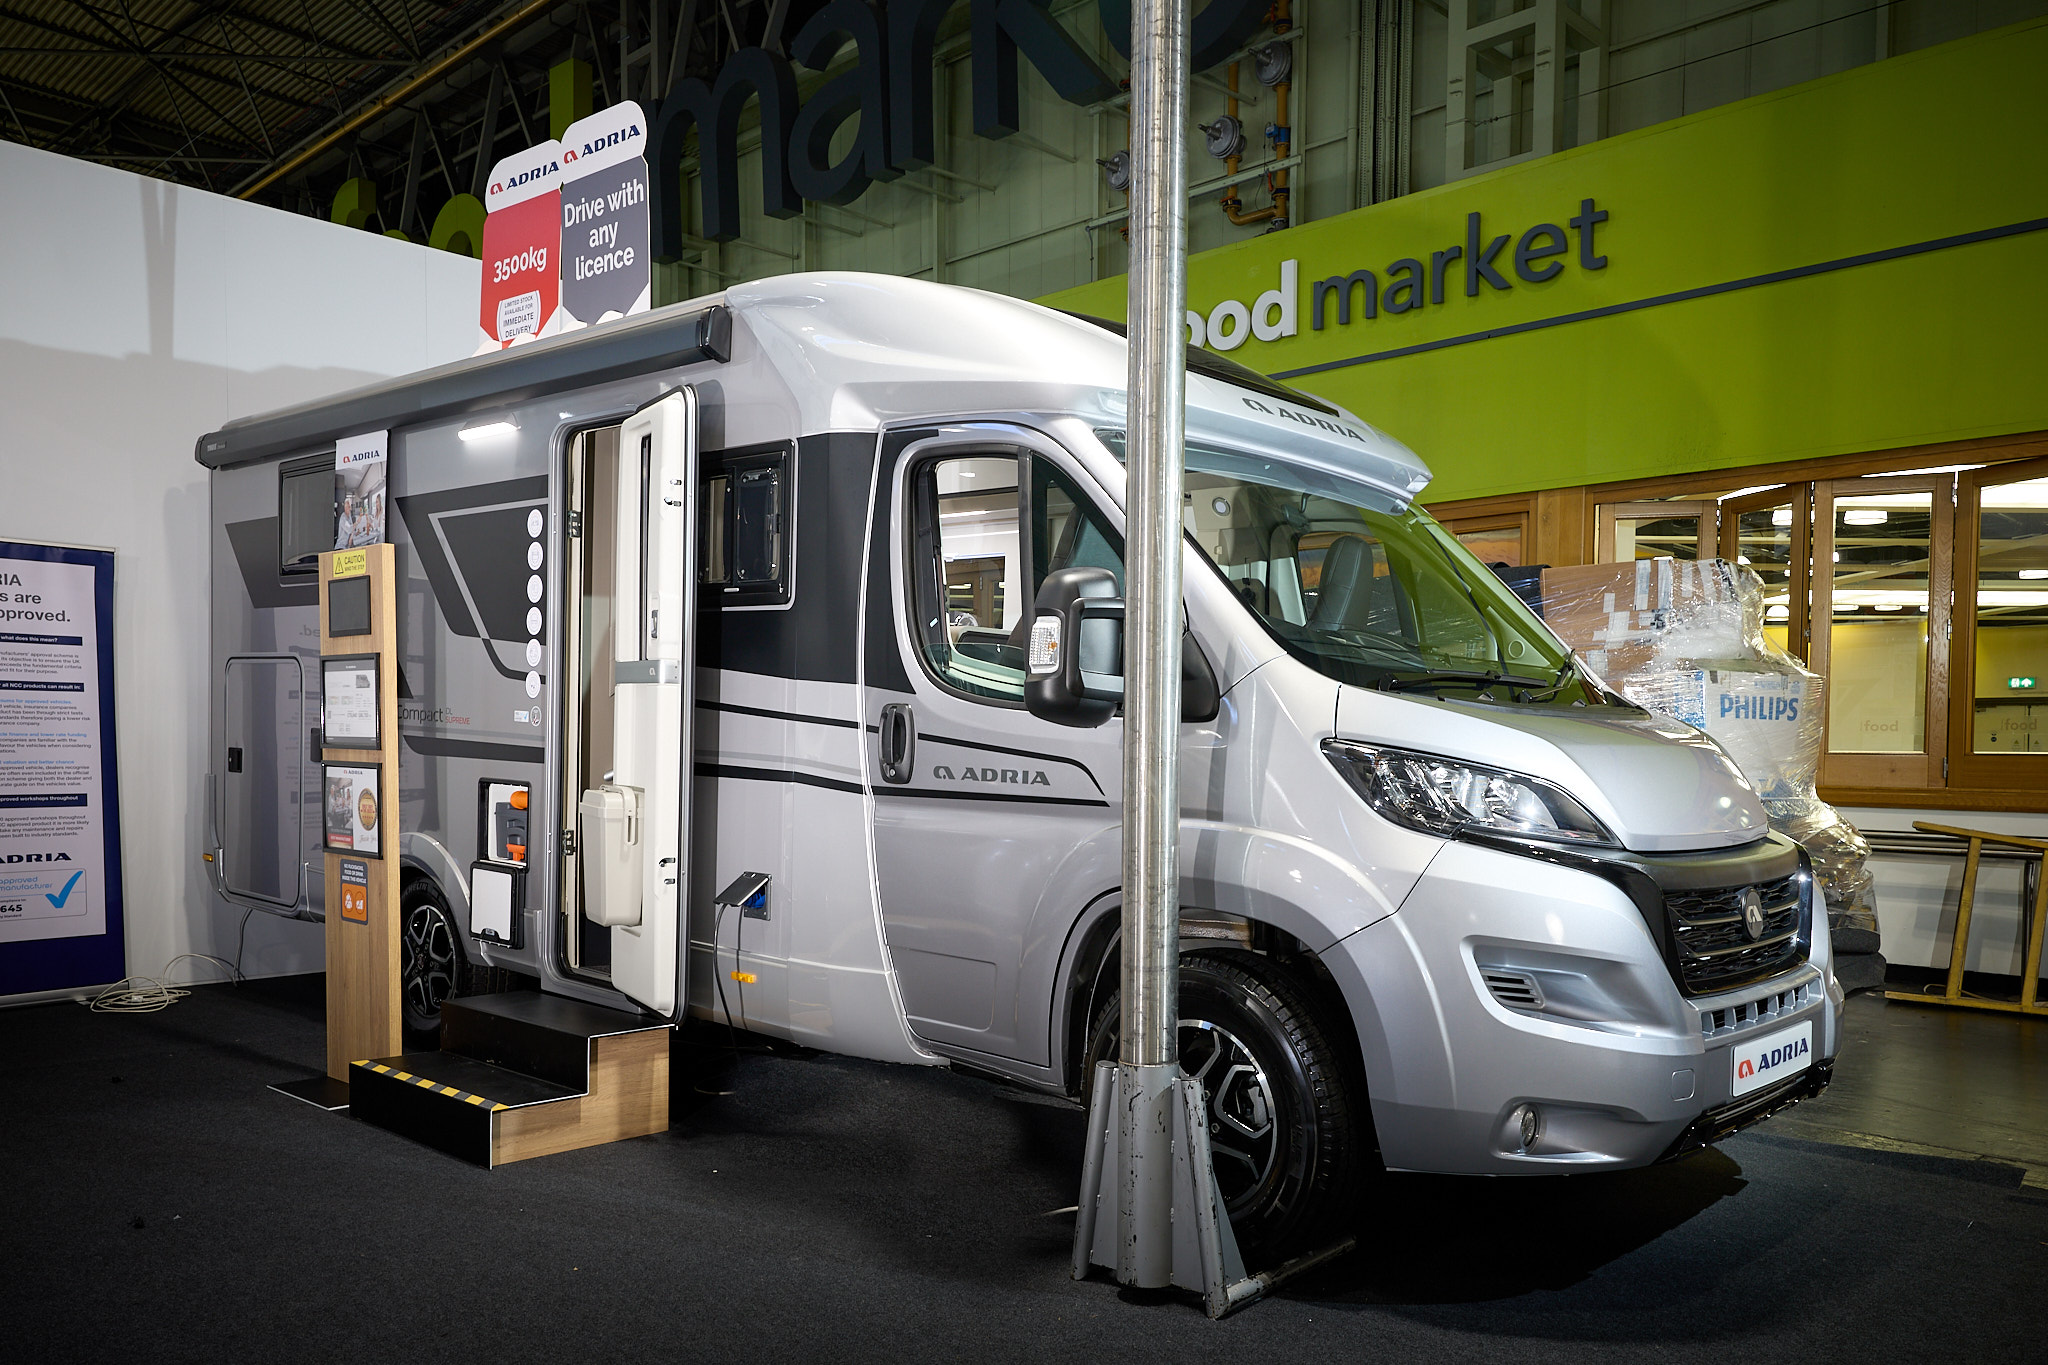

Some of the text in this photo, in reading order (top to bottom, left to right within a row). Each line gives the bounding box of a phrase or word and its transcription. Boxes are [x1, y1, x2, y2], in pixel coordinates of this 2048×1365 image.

[581, 125, 641, 158] ADRIA
[506, 161, 560, 191] ADRIA
[564, 178, 645, 228] Drive with
[589, 221, 619, 249] any
[493, 245, 548, 284] 3500kg
[575, 246, 635, 281] licence
[1312, 197, 1608, 331] market
[504, 295, 533, 309] LIMITED STOCK
[504, 302, 533, 316] AVAILABLE FOR
[503, 311, 534, 327] IMMEDIATE
[505, 324, 532, 338] DELIVERY
[1278, 405, 1366, 443] ADRIA
[352, 450, 380, 462] ADRIA
[344, 554, 365, 565] CAUTION
[0, 573, 22, 586] IA
[15, 593, 41, 604] are
[445, 707, 453, 715] DL
[1720, 694, 1799, 722] PHILIPS
[445, 716, 471, 725] SUPREME
[1863, 720, 1899, 732] food
[2005, 718, 2038, 732] food
[961, 767, 1051, 786] ADRIA
[1758, 1037, 1809, 1073] ADRIA
